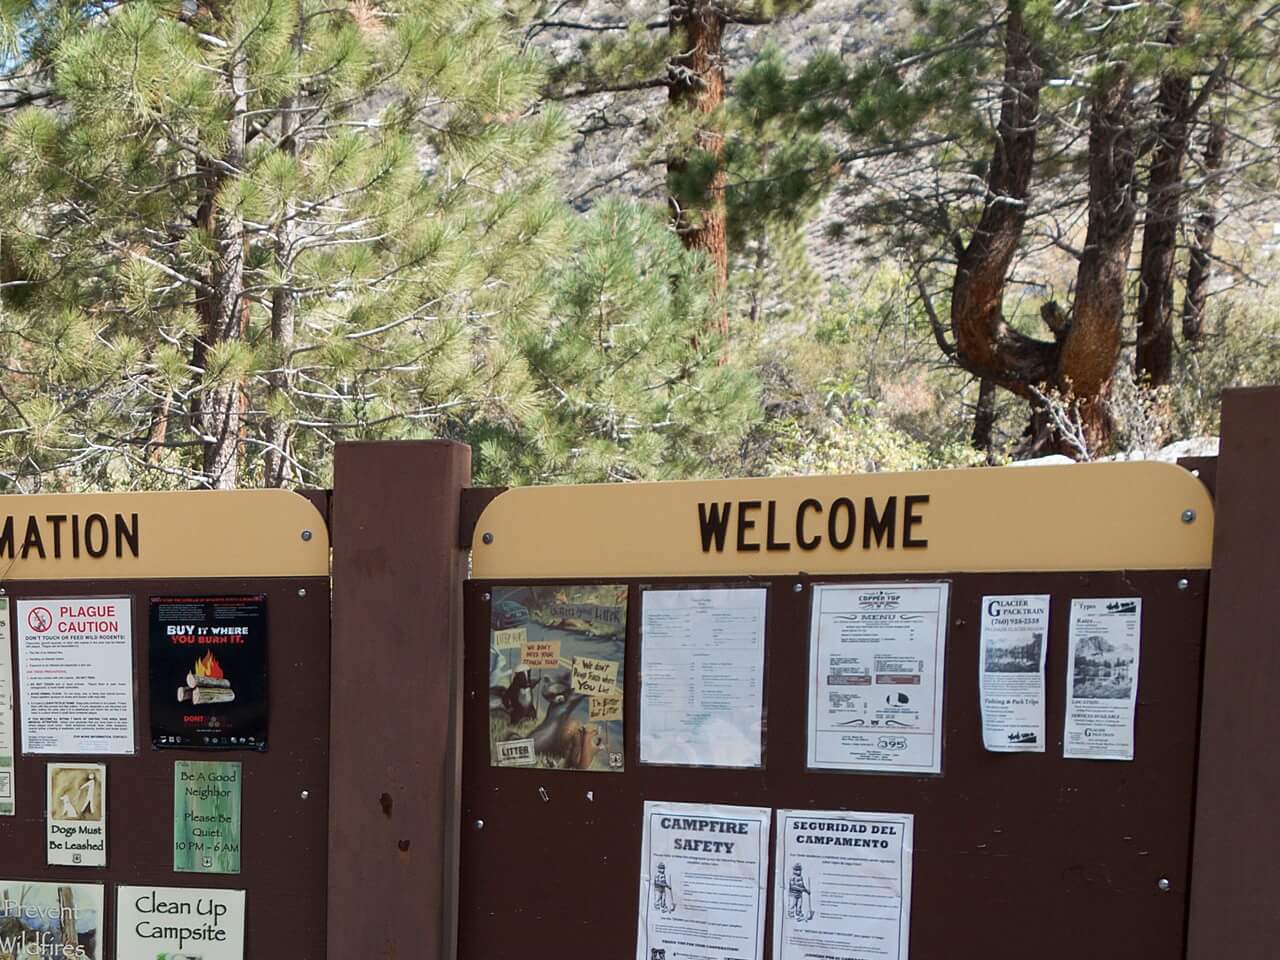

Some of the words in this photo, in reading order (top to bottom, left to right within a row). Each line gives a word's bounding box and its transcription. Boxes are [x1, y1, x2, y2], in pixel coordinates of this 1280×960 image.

[699, 494, 930, 554] WELCOME
[60, 606, 116, 617] PLAGUE
[58, 621, 119, 632] CAUTION
[167, 625, 195, 635] BUY
[198, 627, 208, 635] IT
[211, 626, 249, 635] WHERE
[172, 635, 195, 644] YOU
[198, 635, 228, 644] BURN
[881, 740, 905, 748] 395
[501, 745, 530, 757] LITTER
[181, 771, 194, 782] Be
[195, 772, 206, 782] A
[207, 772, 236, 783] Good
[185, 785, 232, 800] Neighbor
[184, 812, 215, 823] Please
[218, 814, 232, 823] Be
[51, 825, 77, 837] Dogs
[78, 824, 102, 835] Must
[660, 817, 749, 835] CAMPFIRE
[793, 821, 867, 833] SEGURIDAD
[871, 825, 897, 835] DEL
[49, 840, 64, 850] Be
[65, 840, 104, 851] Leashed
[176, 841, 186, 851] 10
[188, 842, 205, 852] PM
[214, 842, 220, 852] 6
[222, 843, 239, 853] AM
[674, 838, 735, 854] SAFETY
[796, 835, 889, 849] CAMPAMENTO
[3, 898, 81, 920] Prevent
[136, 890, 191, 915] Clean
[196, 899, 227, 926] Up
[136, 921, 226, 950] Campsite
